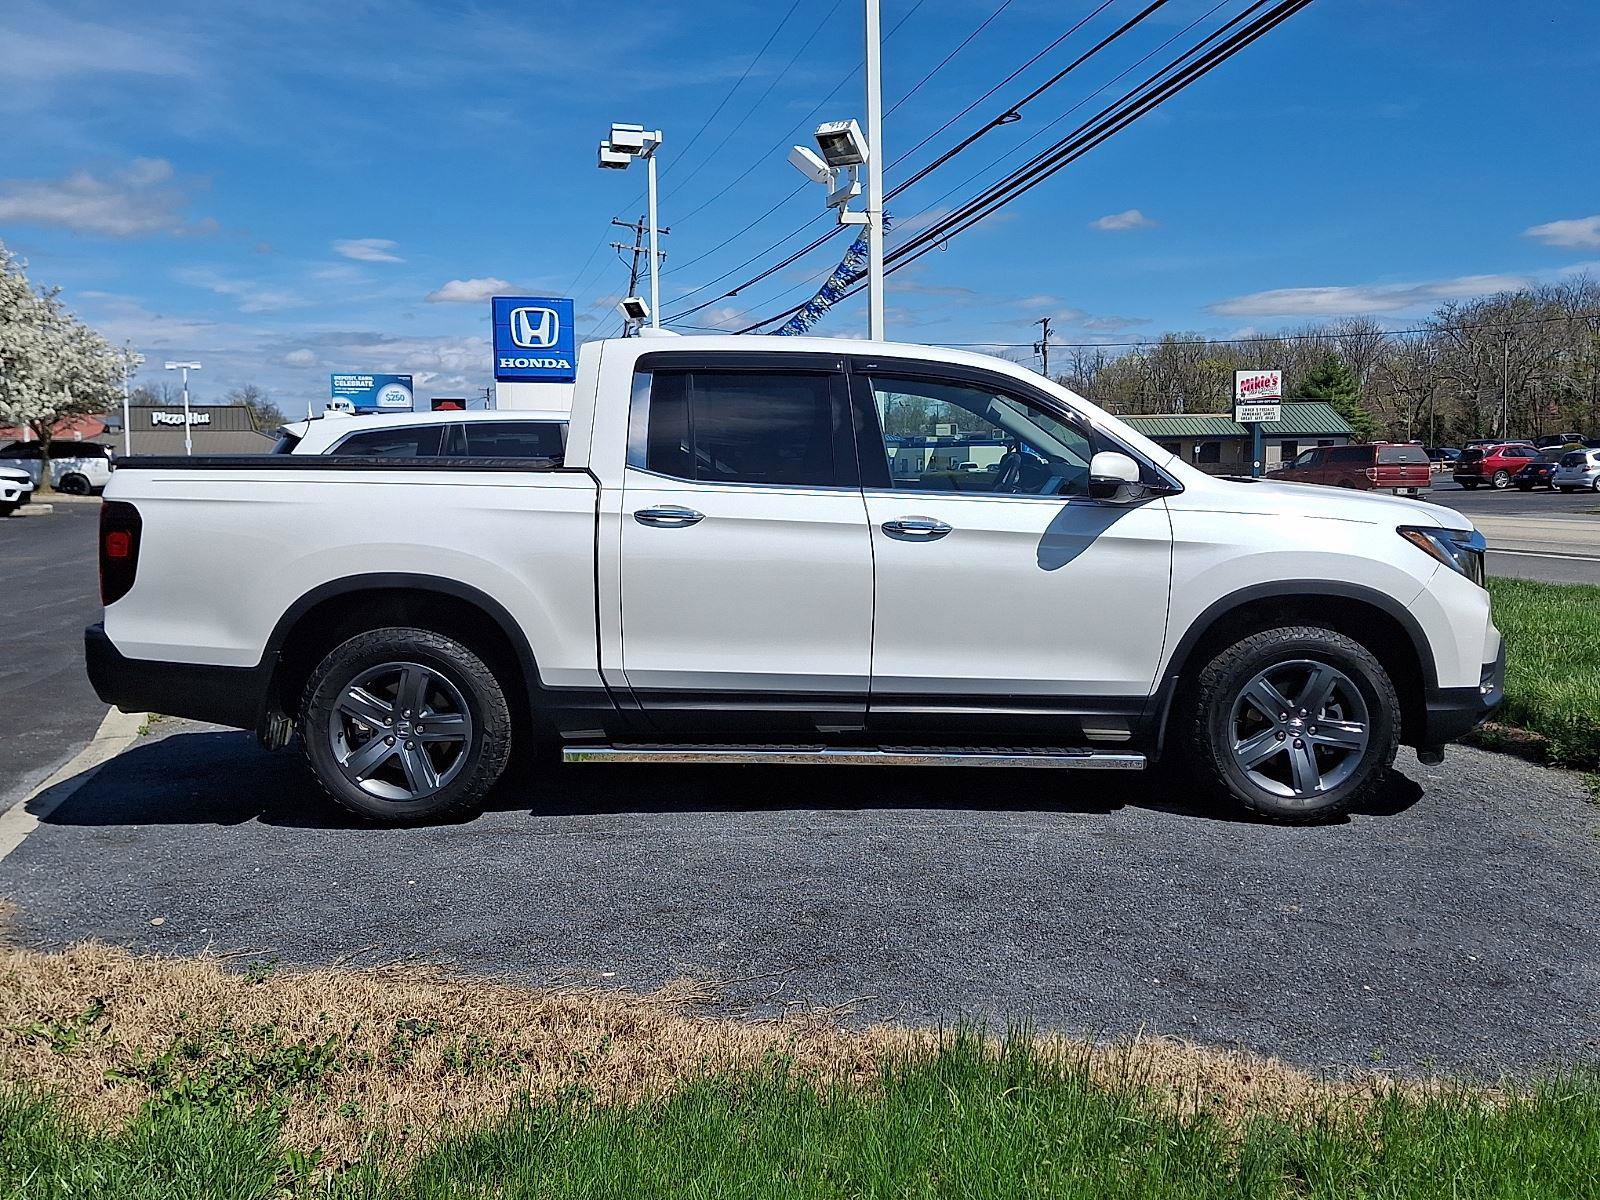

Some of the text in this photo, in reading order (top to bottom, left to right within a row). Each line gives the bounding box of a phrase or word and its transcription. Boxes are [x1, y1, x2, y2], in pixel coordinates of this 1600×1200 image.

[500, 358, 572, 369] HONDA
[1240, 373, 1278, 393] Mikie's
[385, 393, 405, 402] $250
[152, 411, 210, 425] Pizza Hut
